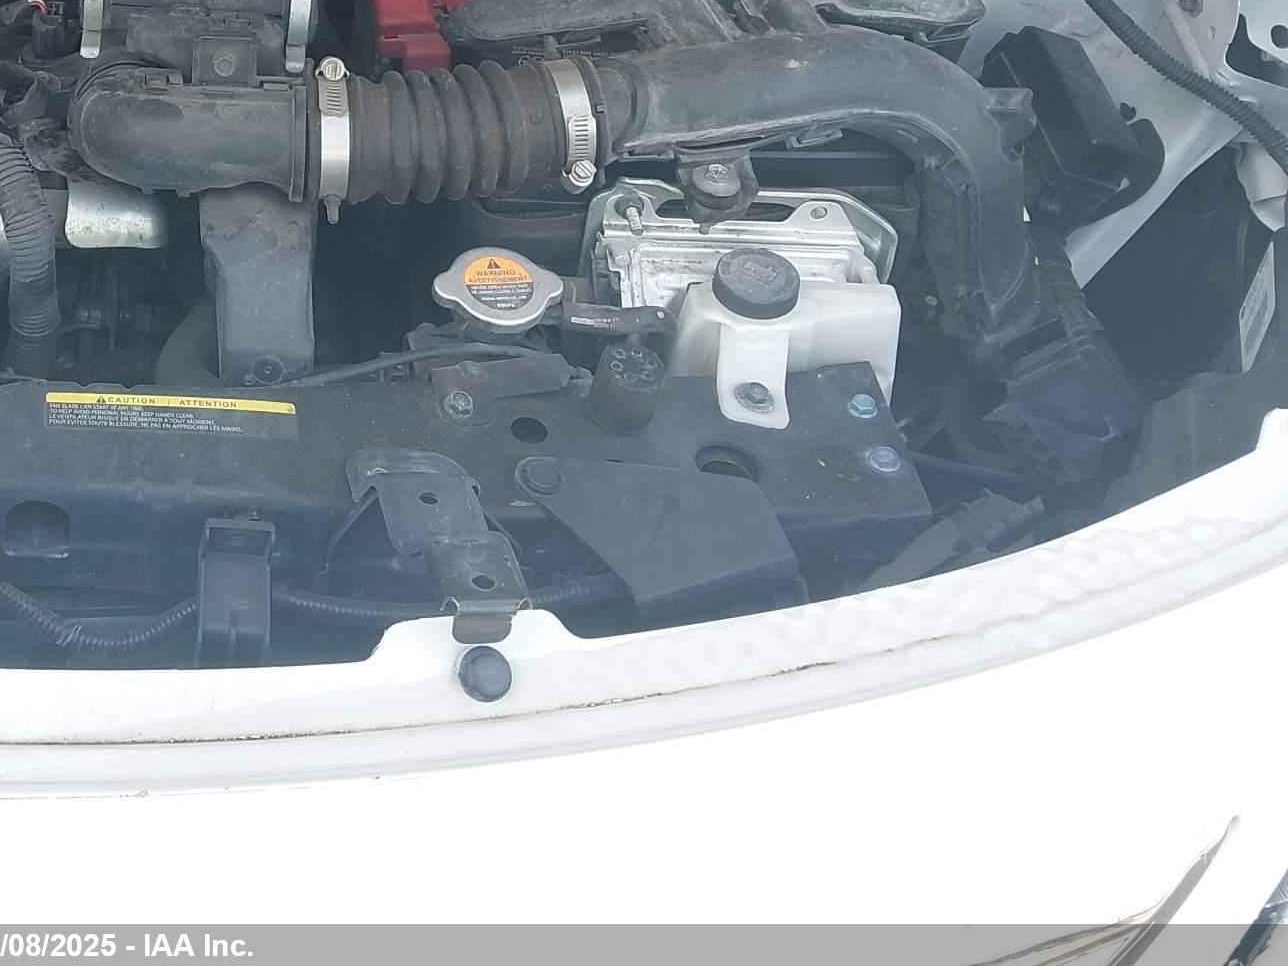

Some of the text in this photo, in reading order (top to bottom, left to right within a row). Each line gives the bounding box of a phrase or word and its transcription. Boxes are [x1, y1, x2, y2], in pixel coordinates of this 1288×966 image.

[475, 269, 516, 277] WARNING
[468, 276, 528, 284] AVERTISSEMENT
[107, 397, 156, 405] CAUTION
[179, 399, 237, 408] ATTENTION
